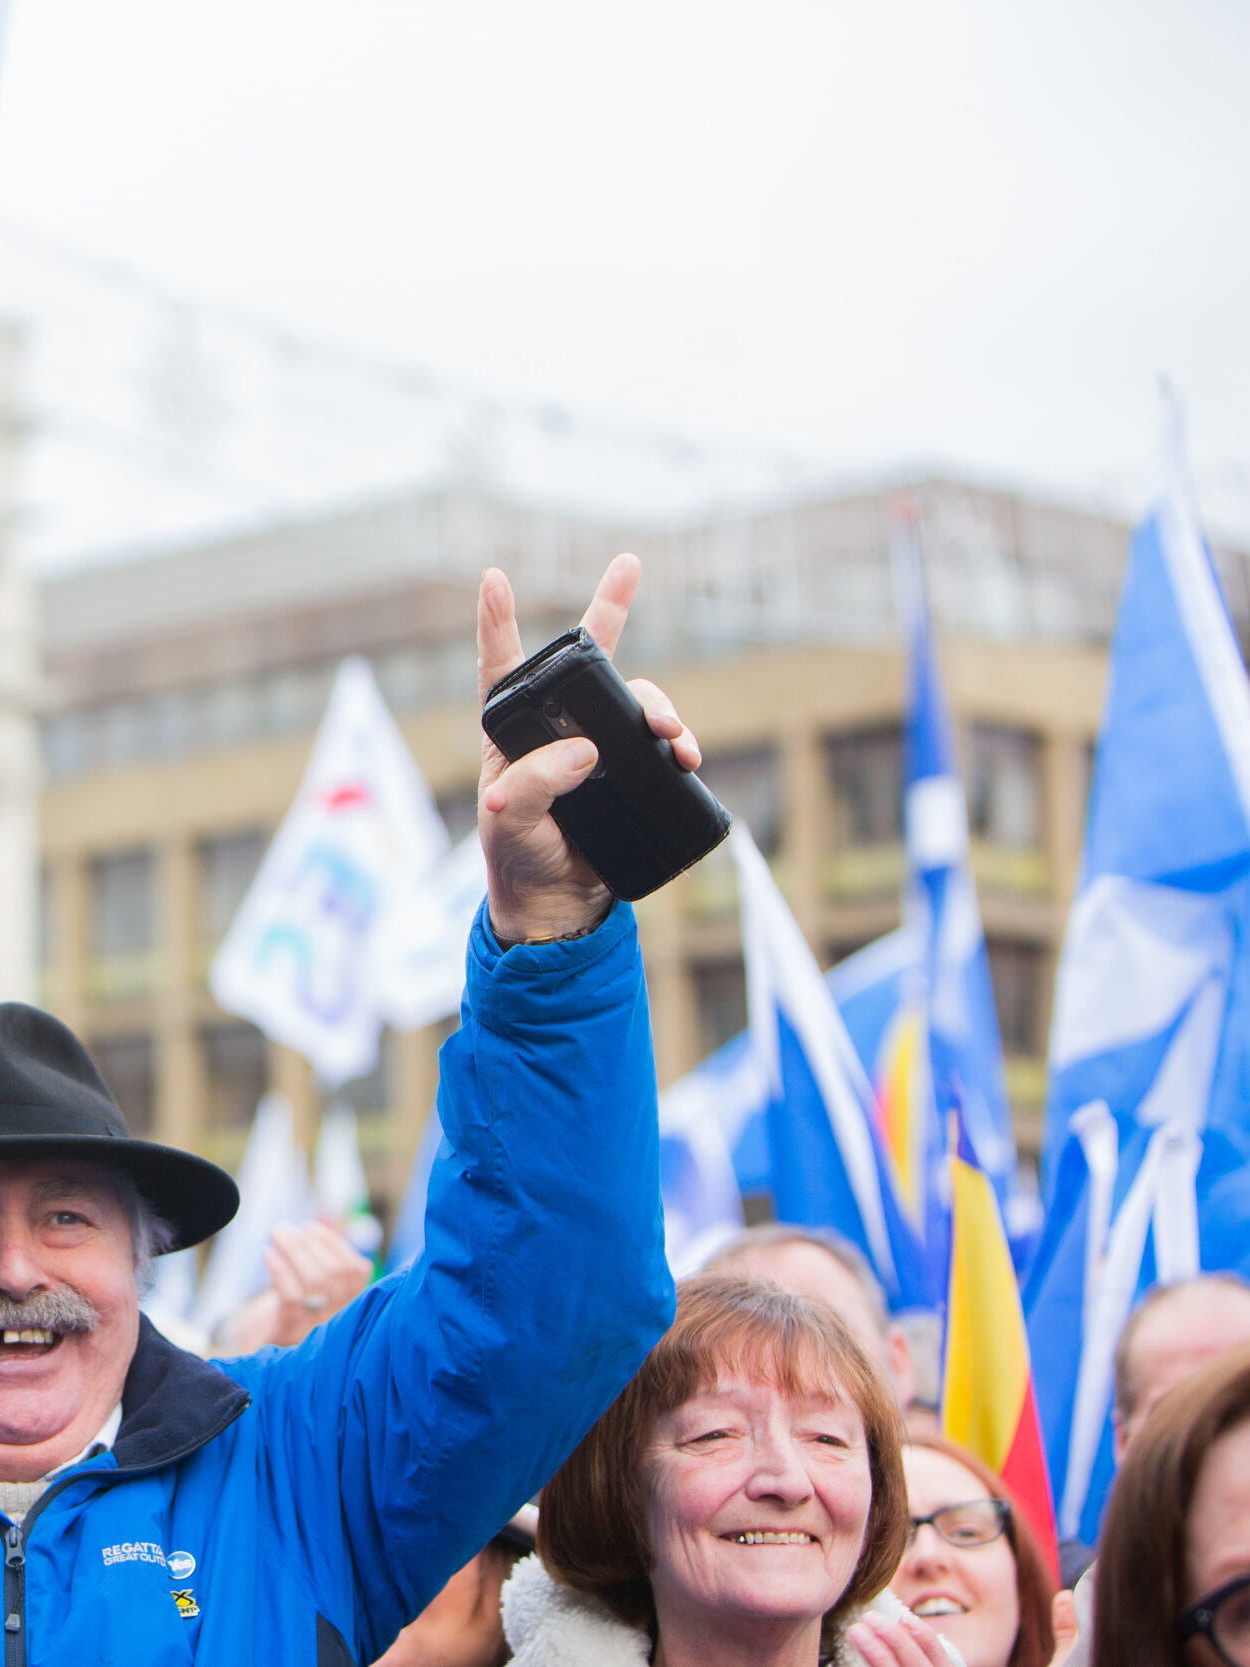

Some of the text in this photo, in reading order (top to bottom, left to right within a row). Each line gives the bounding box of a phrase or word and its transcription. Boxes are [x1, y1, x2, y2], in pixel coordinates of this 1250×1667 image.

[102, 1542, 164, 1558] REGATTA
[104, 1552, 166, 1567] GREAT OUTD
